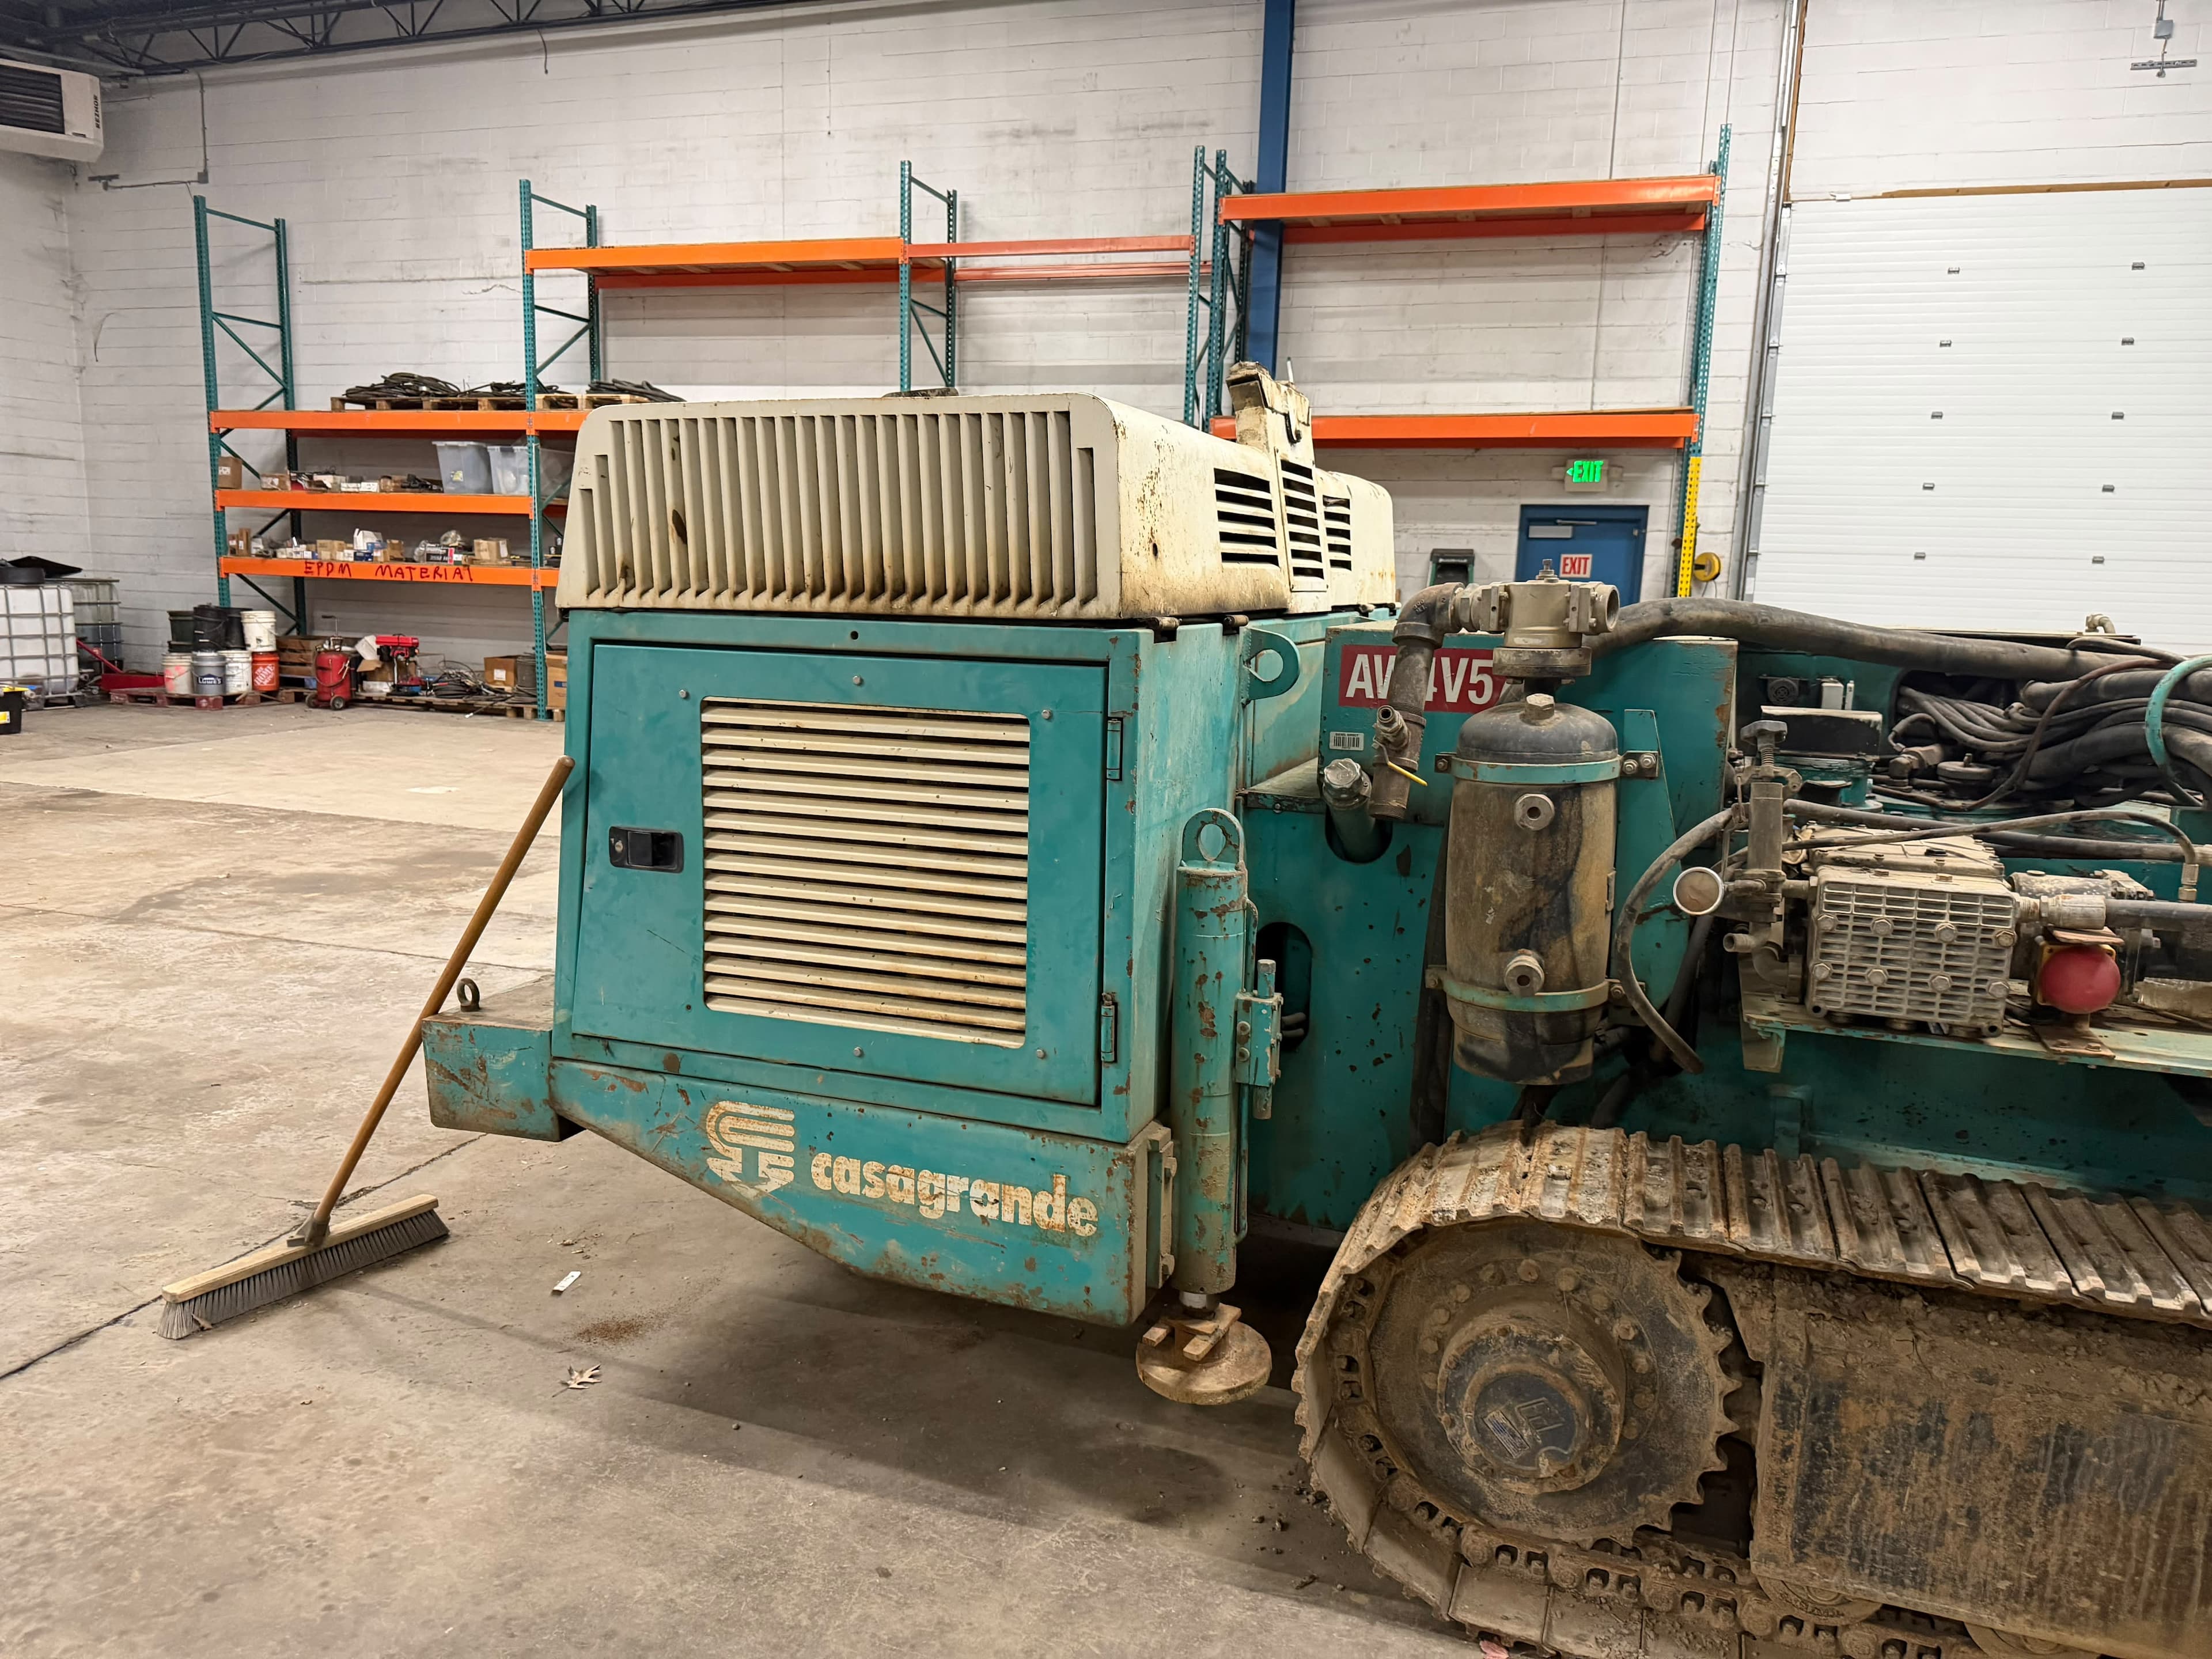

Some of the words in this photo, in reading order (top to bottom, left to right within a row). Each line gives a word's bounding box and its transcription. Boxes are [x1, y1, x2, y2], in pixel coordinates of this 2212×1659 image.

[1573, 460, 1604, 483] EXIT
[304, 560, 352, 577] EPDM
[1562, 557, 1590, 575] EXIT
[810, 1152, 1098, 1237] casagrande
